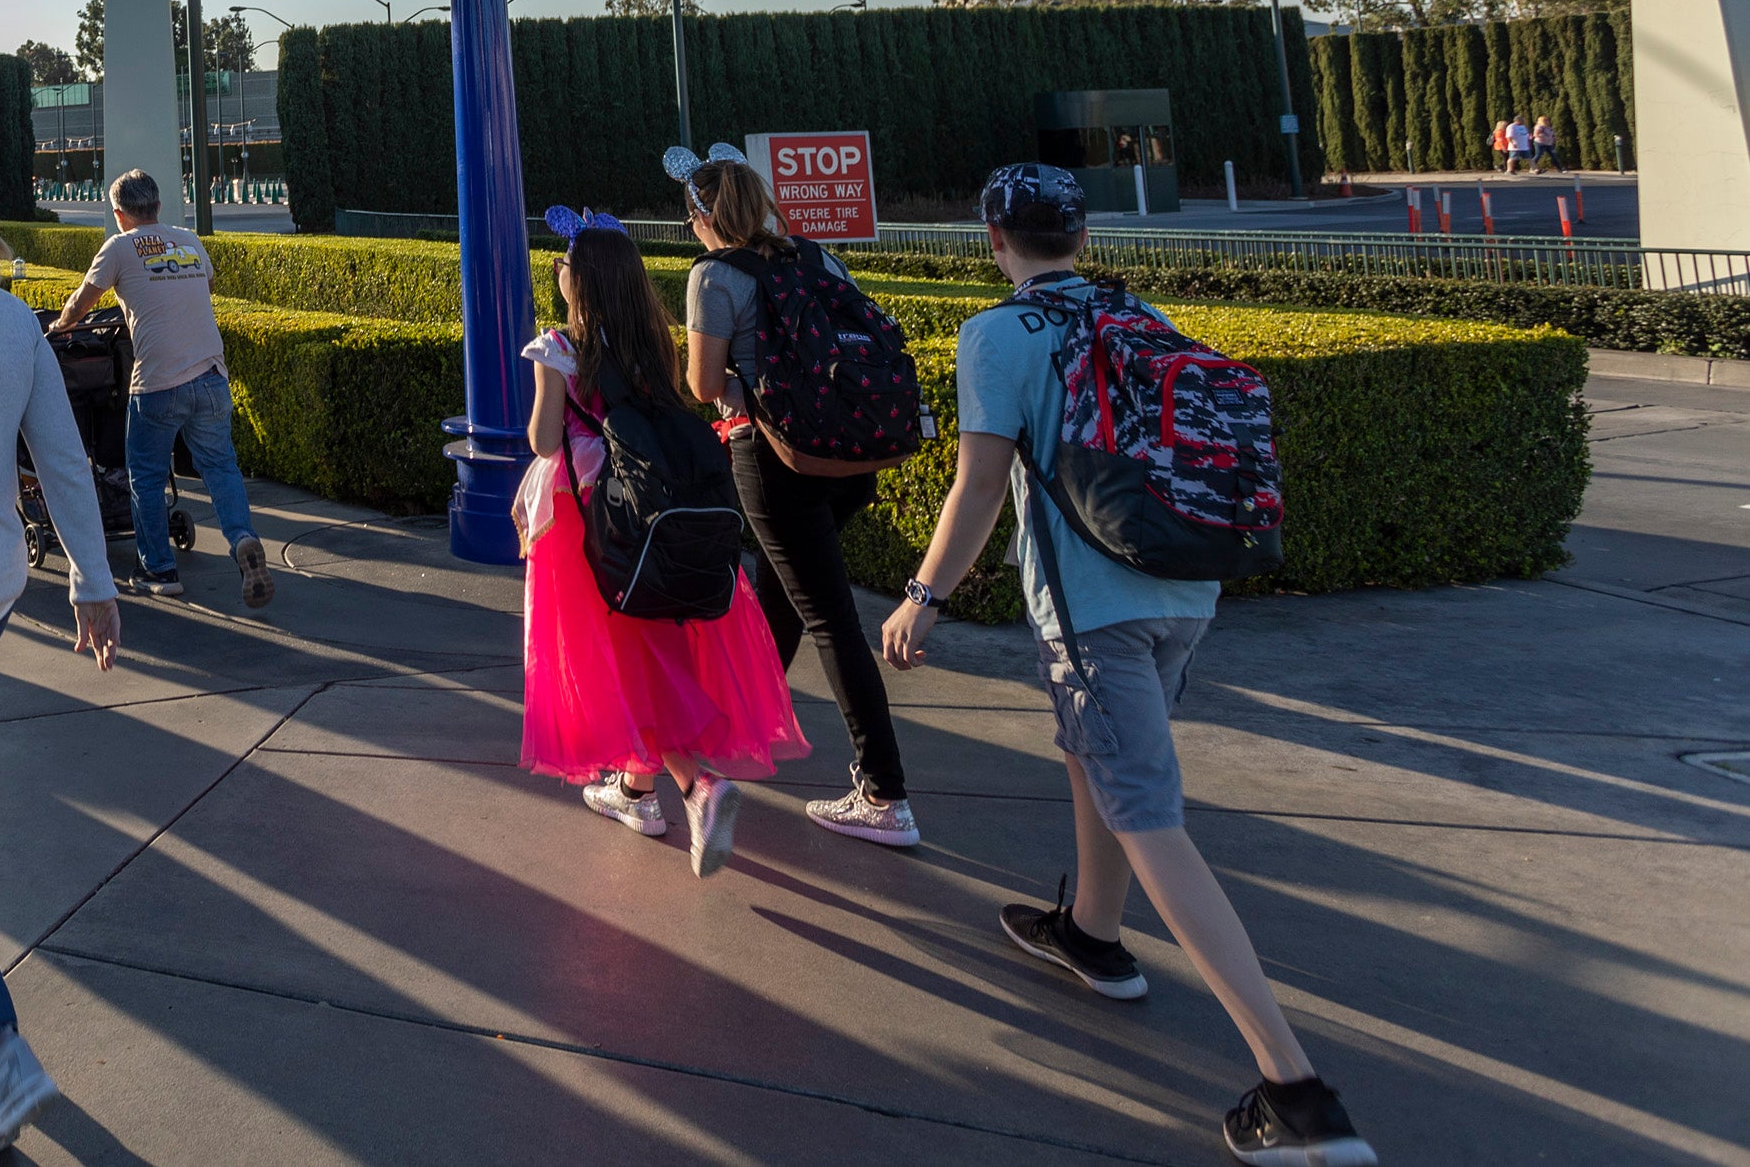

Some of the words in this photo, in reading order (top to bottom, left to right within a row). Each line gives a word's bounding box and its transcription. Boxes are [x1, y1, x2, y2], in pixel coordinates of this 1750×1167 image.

[777, 146, 861, 175] STOP
[779, 184, 829, 200] WRONG
[835, 183, 864, 198] WAY
[789, 207, 831, 220] SEVERE
[835, 207, 859, 219] TIRE
[802, 220, 848, 233] DAMAGE
[133, 235, 164, 248] PIZZA
[137, 245, 166, 256] PLANET
[1018, 306, 1069, 334] DO
